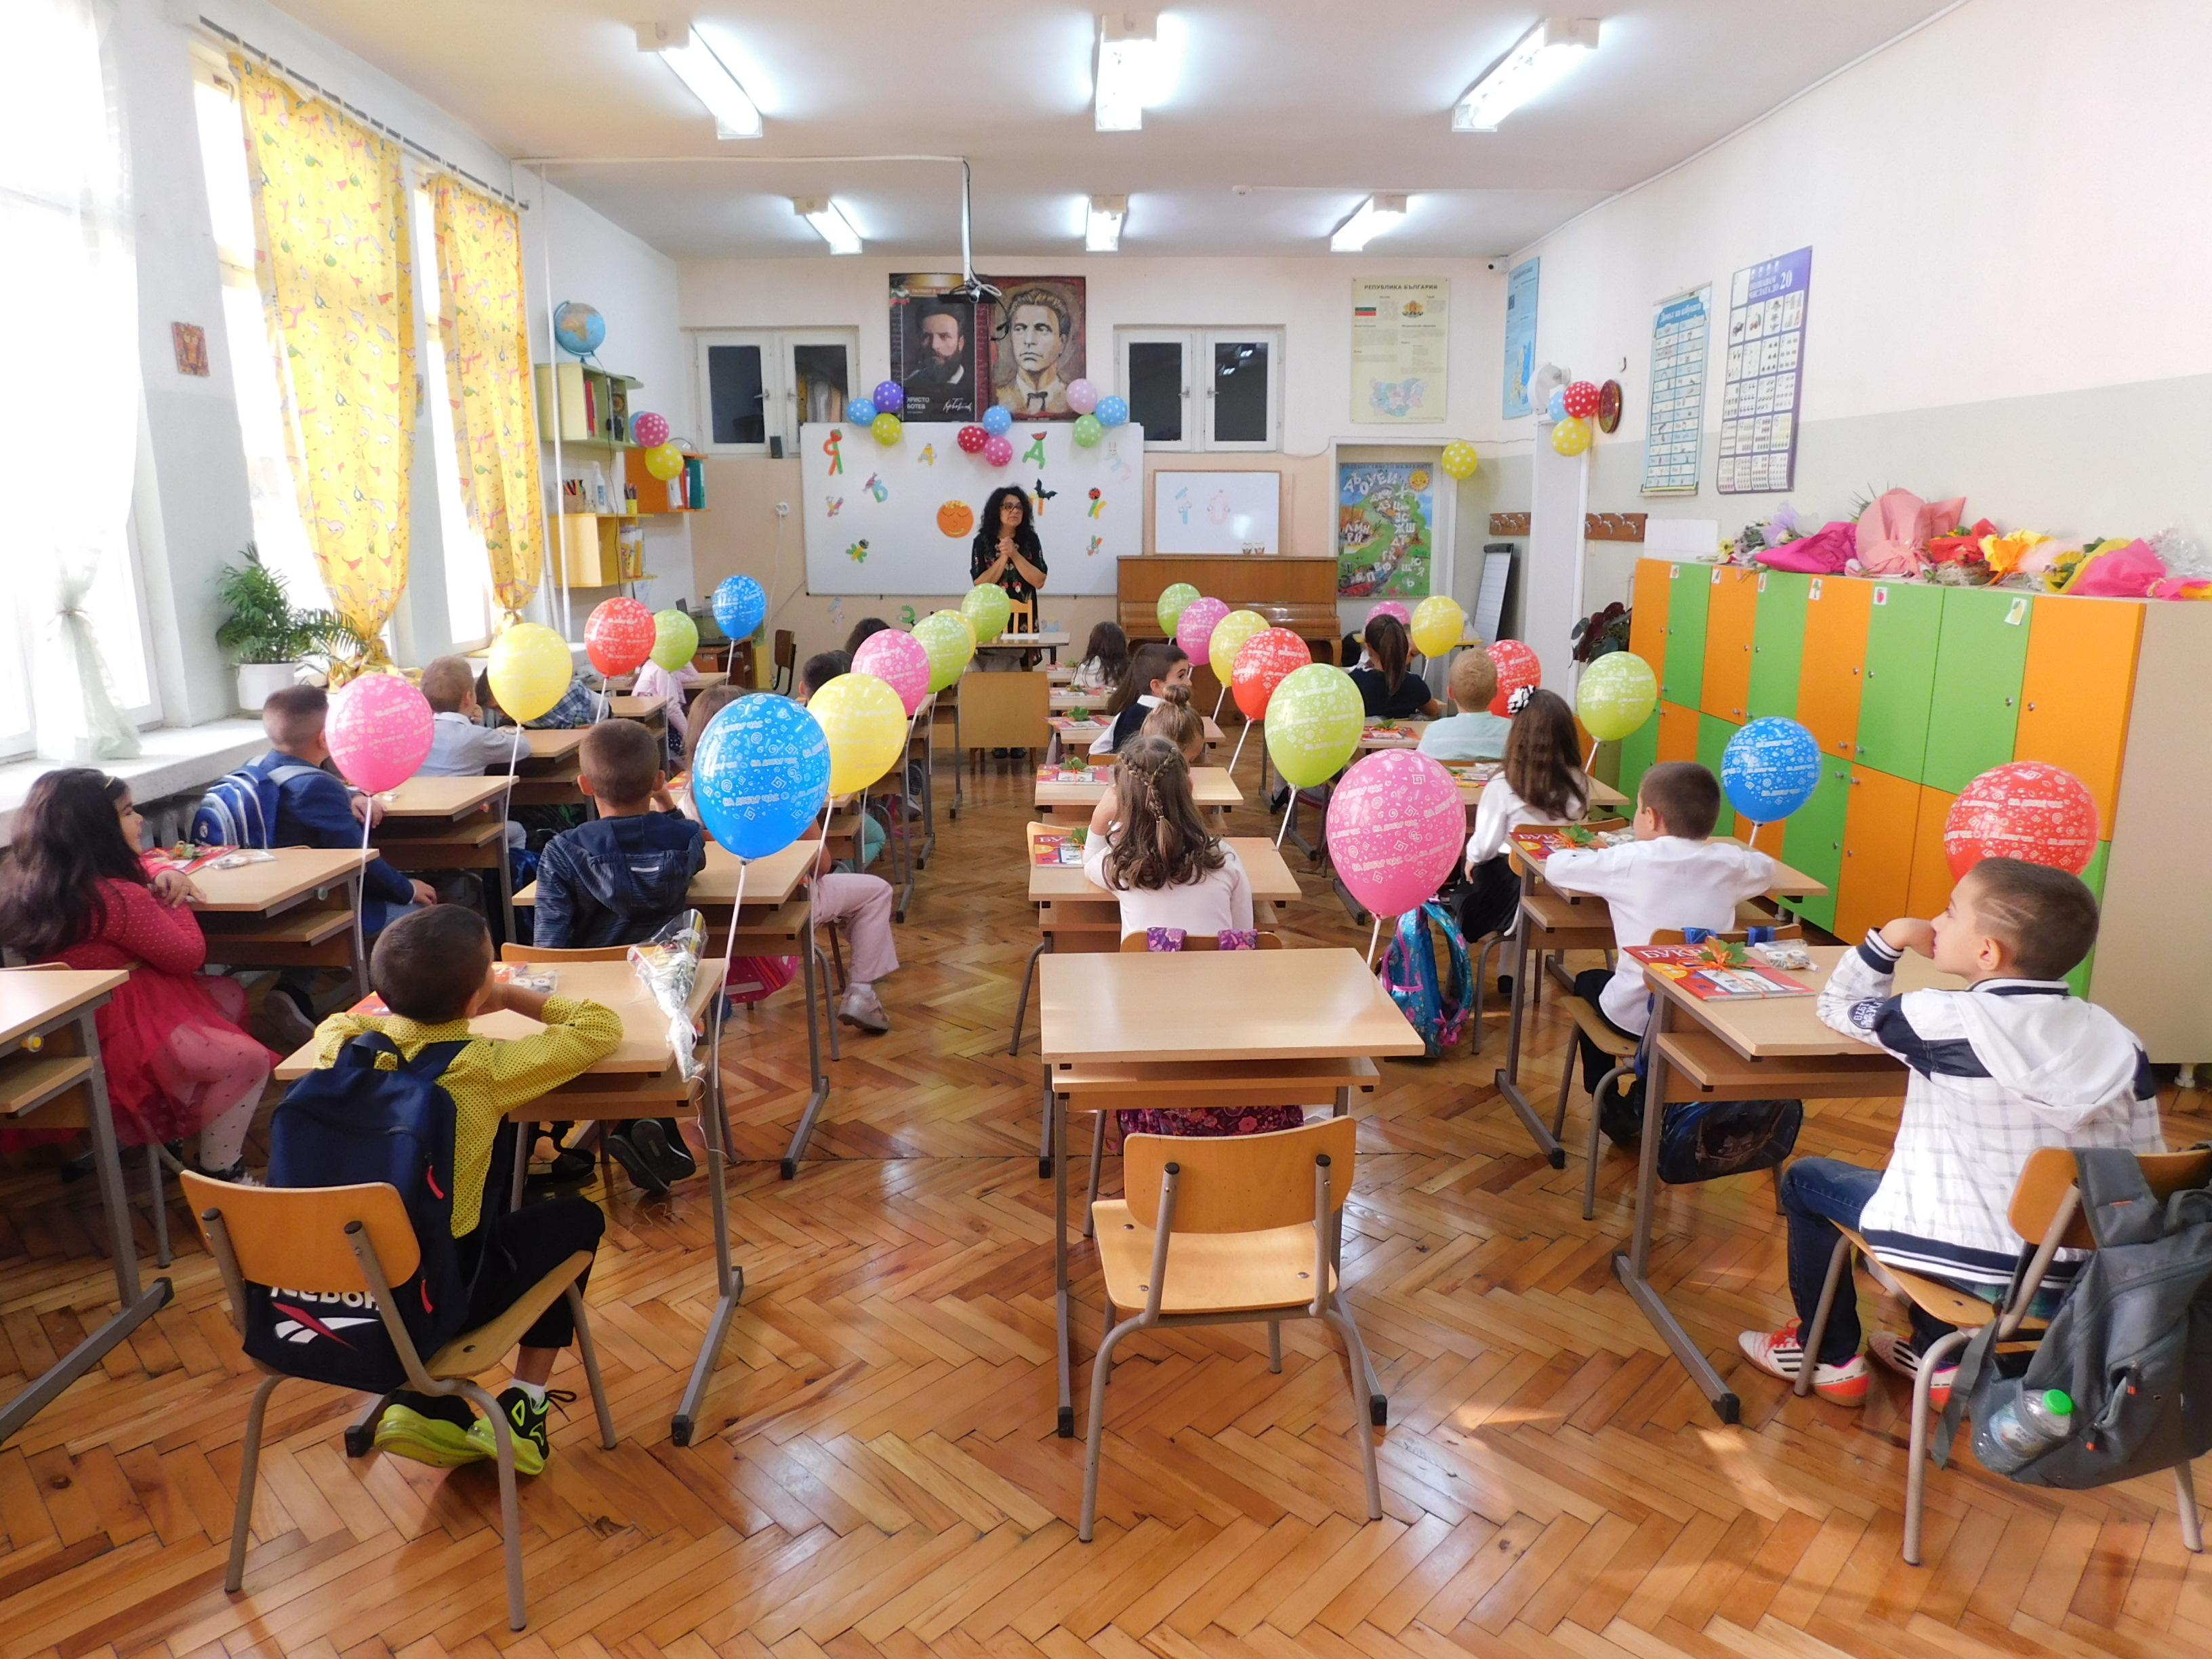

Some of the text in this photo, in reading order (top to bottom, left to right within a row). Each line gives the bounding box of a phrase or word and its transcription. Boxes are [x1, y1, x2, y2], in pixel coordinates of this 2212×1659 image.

[1780, 270, 1793, 290] 20
[747, 720, 763, 729] ЧАС
[1367, 783, 1383, 794] ЧАС
[722, 793, 780, 807] НА ДОБЪР ЧАС
[1351, 862, 1363, 872] НА
[1386, 856, 1404, 866] ЧАС
[1639, 949, 1702, 958] БУКВ
